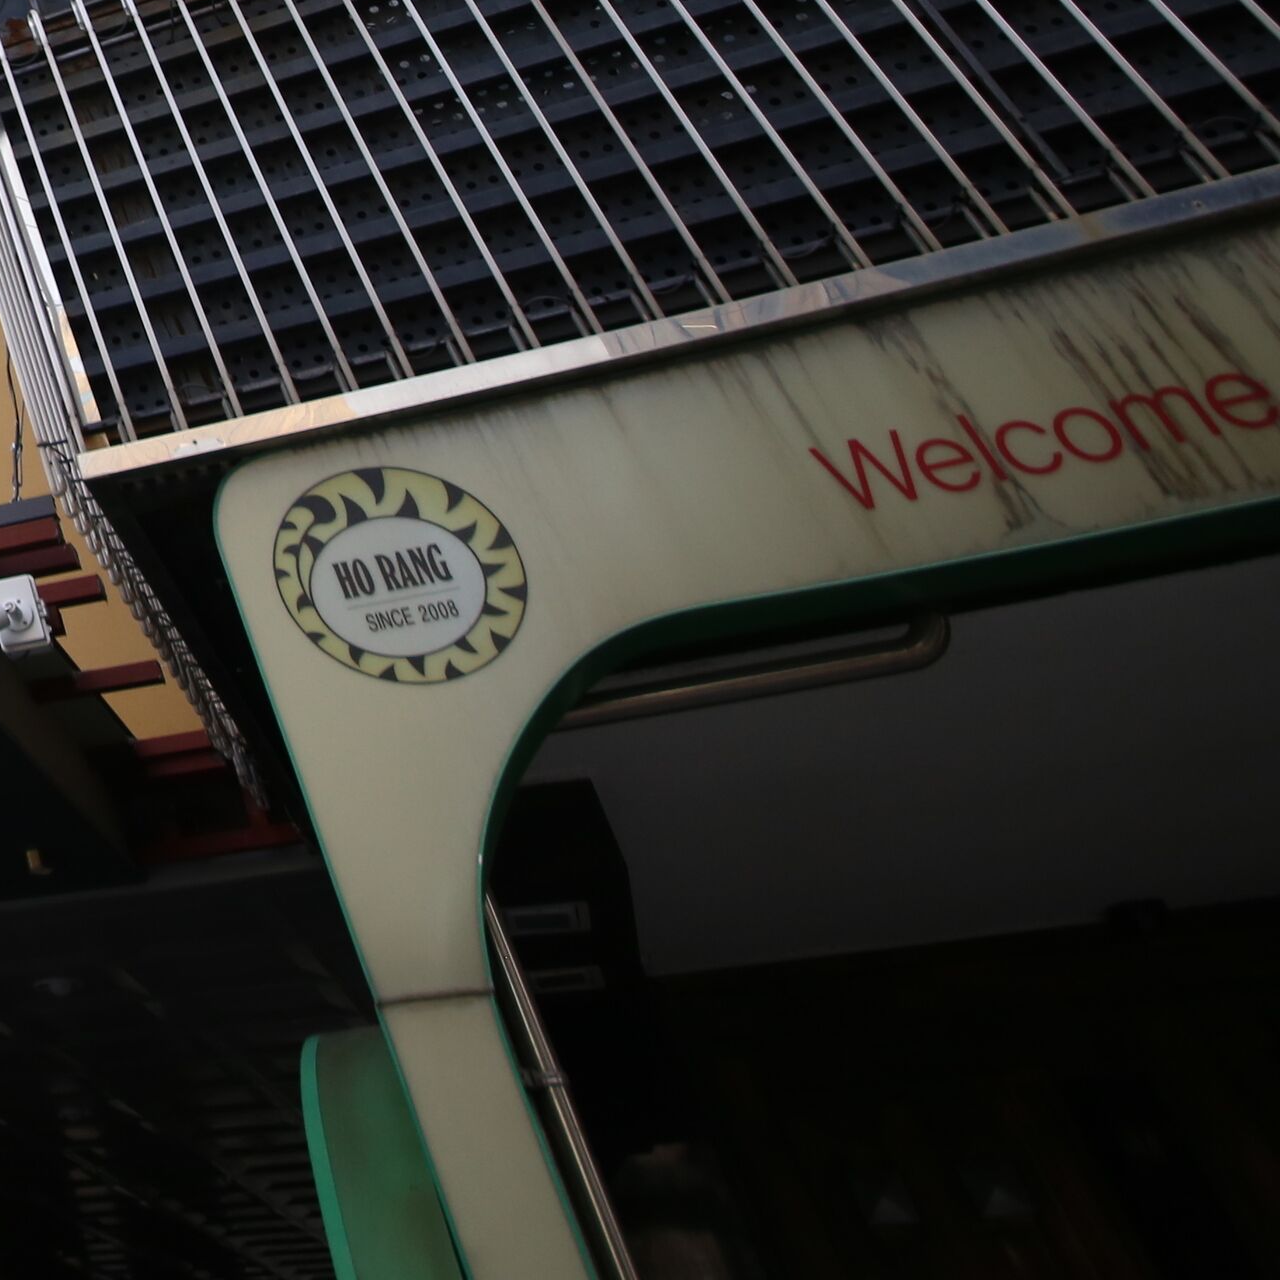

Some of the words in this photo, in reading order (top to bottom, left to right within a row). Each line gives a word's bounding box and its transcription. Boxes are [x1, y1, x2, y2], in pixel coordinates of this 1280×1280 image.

[808, 372, 1280, 511] Welcome
[332, 558, 376, 600] HO
[374, 543, 454, 592] RANG
[365, 607, 416, 633] SINCE
[418, 599, 460, 622] 2008
